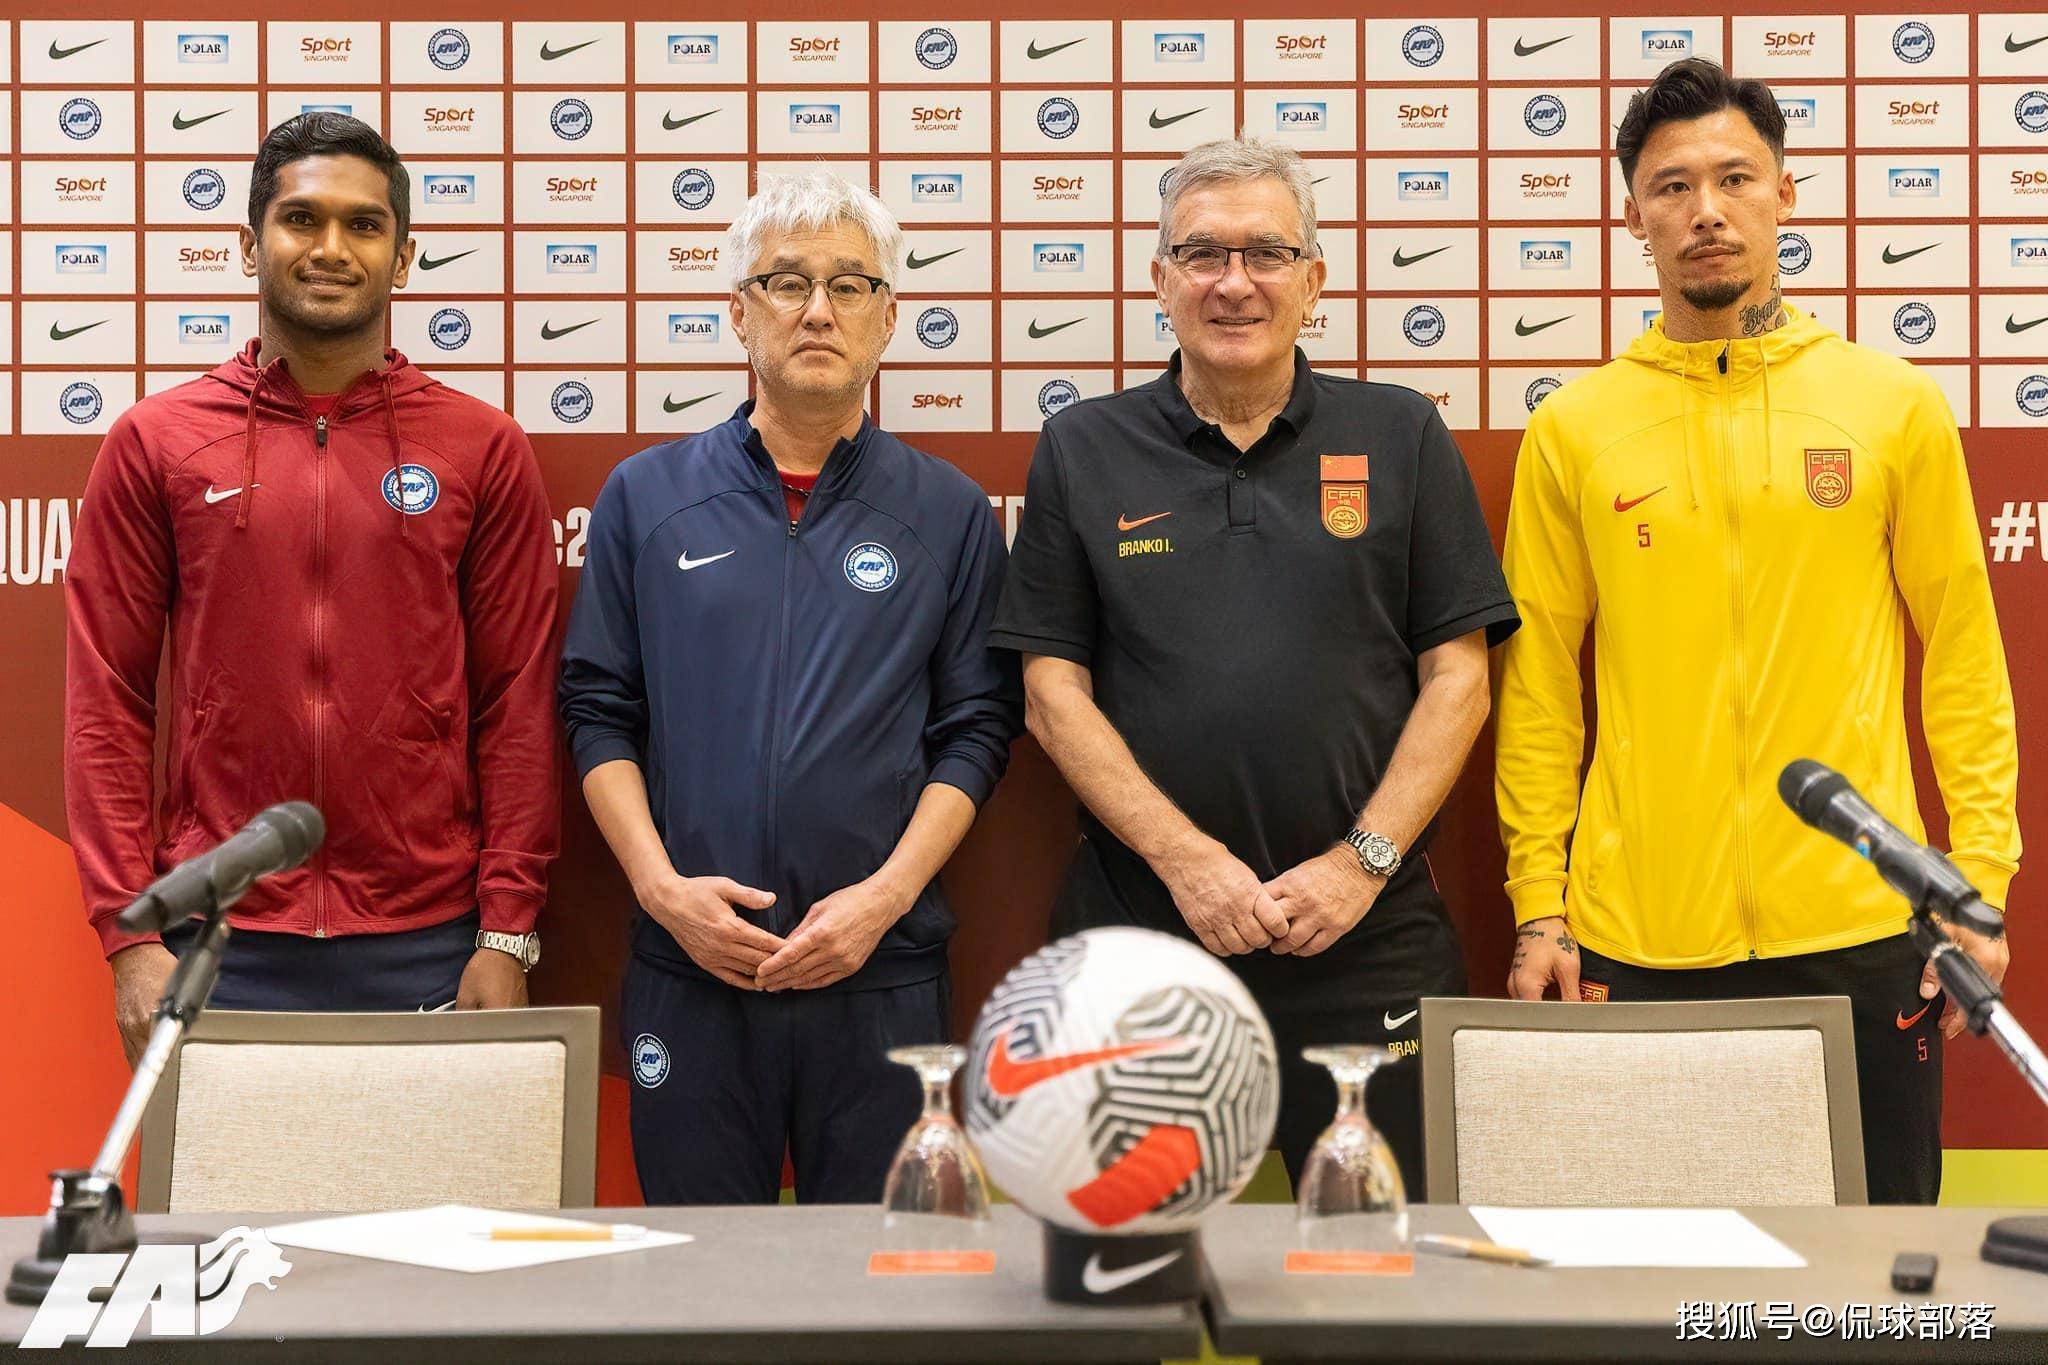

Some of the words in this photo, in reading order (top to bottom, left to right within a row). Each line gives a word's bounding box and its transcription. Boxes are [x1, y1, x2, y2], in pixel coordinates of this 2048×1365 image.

[1276, 35, 1327, 52] Sport
[1764, 31, 1815, 48] Sport
[184, 44, 222, 54] POLAR
[300, 37, 352, 54] Sport
[674, 44, 712, 54] POLAR
[788, 37, 840, 54] Sport
[1160, 42, 1198, 52] POLAR
[1648, 40, 1686, 50] POLAR
[1398, 104, 1449, 121] Sport
[1888, 100, 1939, 117] Sport
[424, 107, 475, 124] Sport
[796, 114, 834, 124] POLAR
[910, 106, 962, 123] Sport
[1282, 112, 1320, 122] POLAR
[1520, 173, 1571, 190] Sport
[1895, 178, 1932, 188] POLAR
[2010, 171, 2048, 187] Spo
[54, 177, 106, 194] Sport
[430, 184, 468, 194] POLAR
[546, 177, 597, 194] Sport
[918, 184, 956, 194] POLAR
[1032, 176, 1084, 193] Sport
[1404, 180, 1442, 190] POLAR
[178, 247, 230, 264] Sport
[668, 247, 719, 264] Sport
[1040, 252, 1078, 262] POLAR
[1526, 250, 1564, 260] POLAR
[2017, 247, 2048, 258] POLA
[62, 254, 100, 264] POLAR
[553, 254, 590, 264] POLAR
[185, 324, 222, 334] POLAR
[675, 324, 712, 334] POLAR
[1811, 454, 1845, 464] CFA
[1328, 490, 1360, 500] CFA
[1638, 524, 1651, 548] 5
[1118, 538, 1162, 558] BRANKO
[1165, 538, 1174, 554] I.
